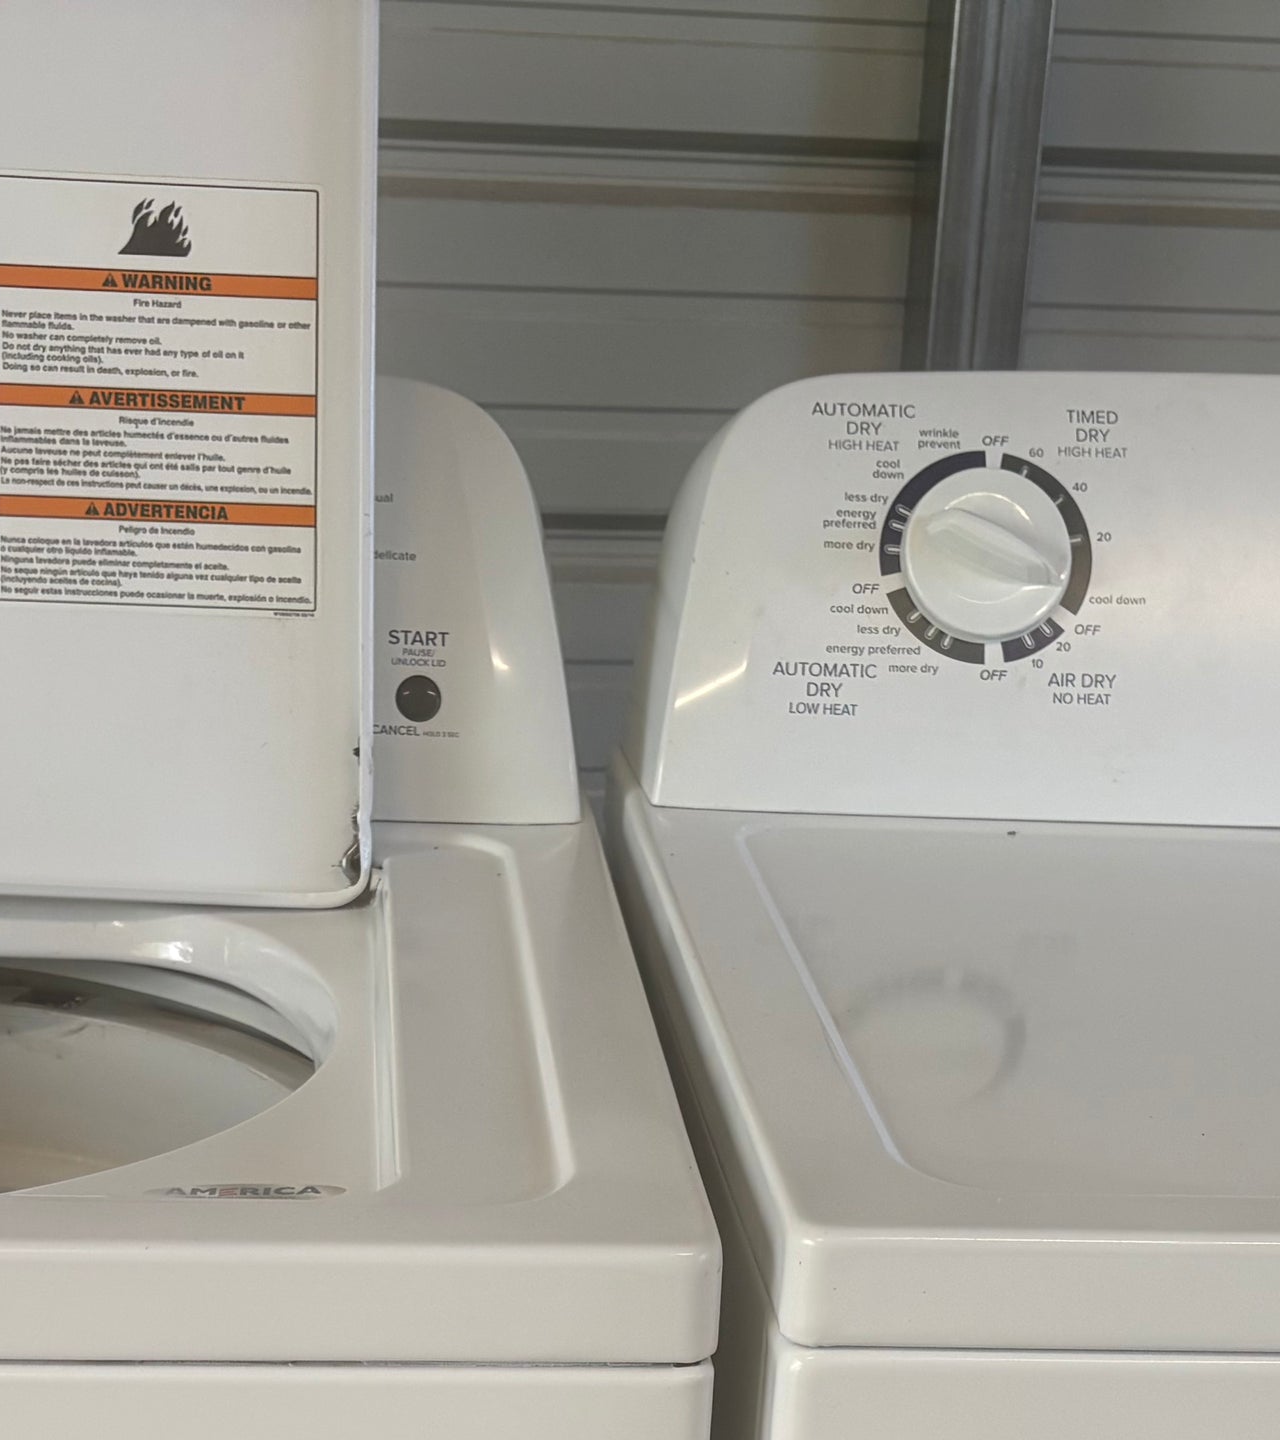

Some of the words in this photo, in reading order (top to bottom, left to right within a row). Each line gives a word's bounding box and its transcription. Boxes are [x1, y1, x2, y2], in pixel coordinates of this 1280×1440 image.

[121, 273, 212, 292] WARNING
[132, 298, 150, 308] Fire
[151, 298, 182, 310] Hazard
[1, 330, 15, 340] No
[16, 332, 47, 341] washer
[49, 333, 65, 341] can
[89, 391, 246, 410] AVERTISSEMENT
[811, 402, 916, 419] AUTOMATIC
[1066, 409, 1119, 425] TIMED
[118, 416, 149, 428] Risque
[845, 420, 883, 436] DRY
[918, 428, 960, 439] wrinkle
[1075, 428, 1110, 443] DRY
[828, 439, 862, 451] HIGH
[865, 440, 900, 452] HEAT
[917, 439, 961, 451] prevent
[981, 435, 1009, 447] OFF
[1028, 447, 1044, 459] 60
[1057, 446, 1092, 459] HIGH
[1094, 447, 1128, 459] HEAT
[876, 459, 901, 469] cool
[872, 469, 905, 481] down
[1072, 482, 1088, 493] 40
[844, 492, 868, 503] less
[870, 493, 889, 506] dry
[103, 502, 229, 520] ADVERTENCIA
[836, 508, 877, 521] energy
[822, 518, 877, 531] preferred
[1096, 531, 1112, 543] 20
[823, 540, 853, 551] more
[855, 540, 875, 553] dry
[852, 583, 880, 595] OFF
[1089, 594, 1114, 605] cool
[1116, 595, 1146, 605] down
[830, 604, 855, 615] cool
[856, 604, 889, 616] down
[856, 624, 880, 635] less
[882, 624, 901, 637] dry
[1074, 624, 1102, 636] OFF
[388, 629, 449, 647] START
[402, 648, 435, 657] PAUSE/
[826, 644, 866, 657] energy
[868, 644, 921, 656] preferred
[1056, 641, 1071, 653] 20
[391, 657, 430, 667] UNLOCK
[431, 659, 447, 667] LID
[1031, 659, 1044, 670] 10
[773, 661, 878, 679] AUTOMATIC
[888, 663, 917, 674] more
[919, 663, 939, 676] dry
[980, 669, 1008, 682] OFF
[1048, 673, 1076, 688] AIR
[1081, 674, 1117, 689] DRY
[806, 681, 843, 698] DRY
[1052, 692, 1073, 705] NO
[1076, 693, 1111, 706] HEAT
[788, 702, 820, 715] LOW
[823, 703, 859, 717] HEAT
[165, 1184, 322, 1197] AMERICA
